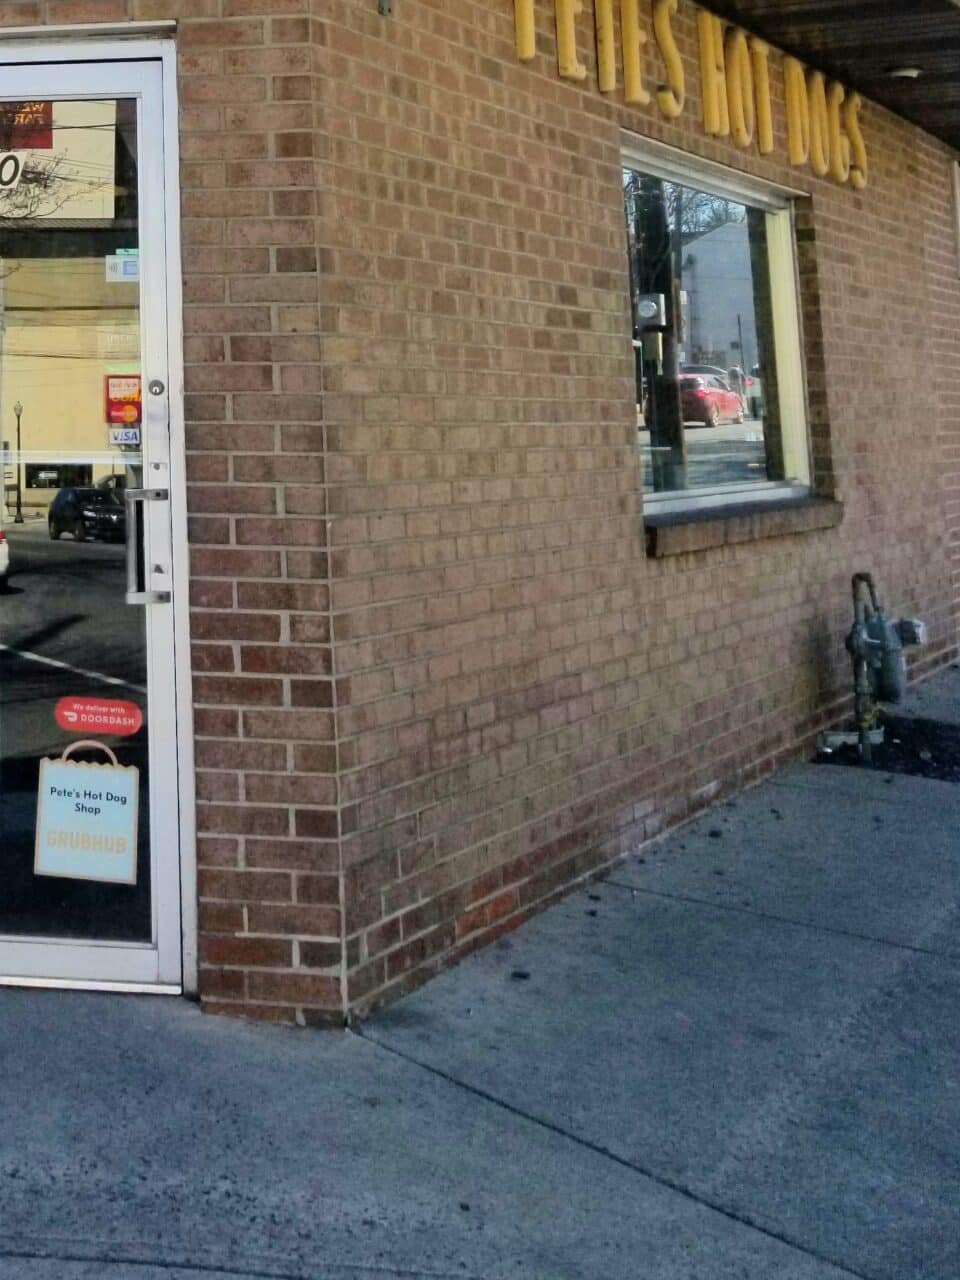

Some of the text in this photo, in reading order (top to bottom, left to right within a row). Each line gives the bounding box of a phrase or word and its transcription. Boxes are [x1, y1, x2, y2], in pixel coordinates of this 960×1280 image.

[697, 8, 774, 155] HOT
[783, 55, 869, 190] DOGS
[112, 431, 138, 441] VISA
[80, 713, 135, 726] DOORDASH
[50, 786, 128, 805] Pete's Hot Dog
[74, 802, 101, 815] Shop
[46, 830, 128, 854] GRUBHUB
